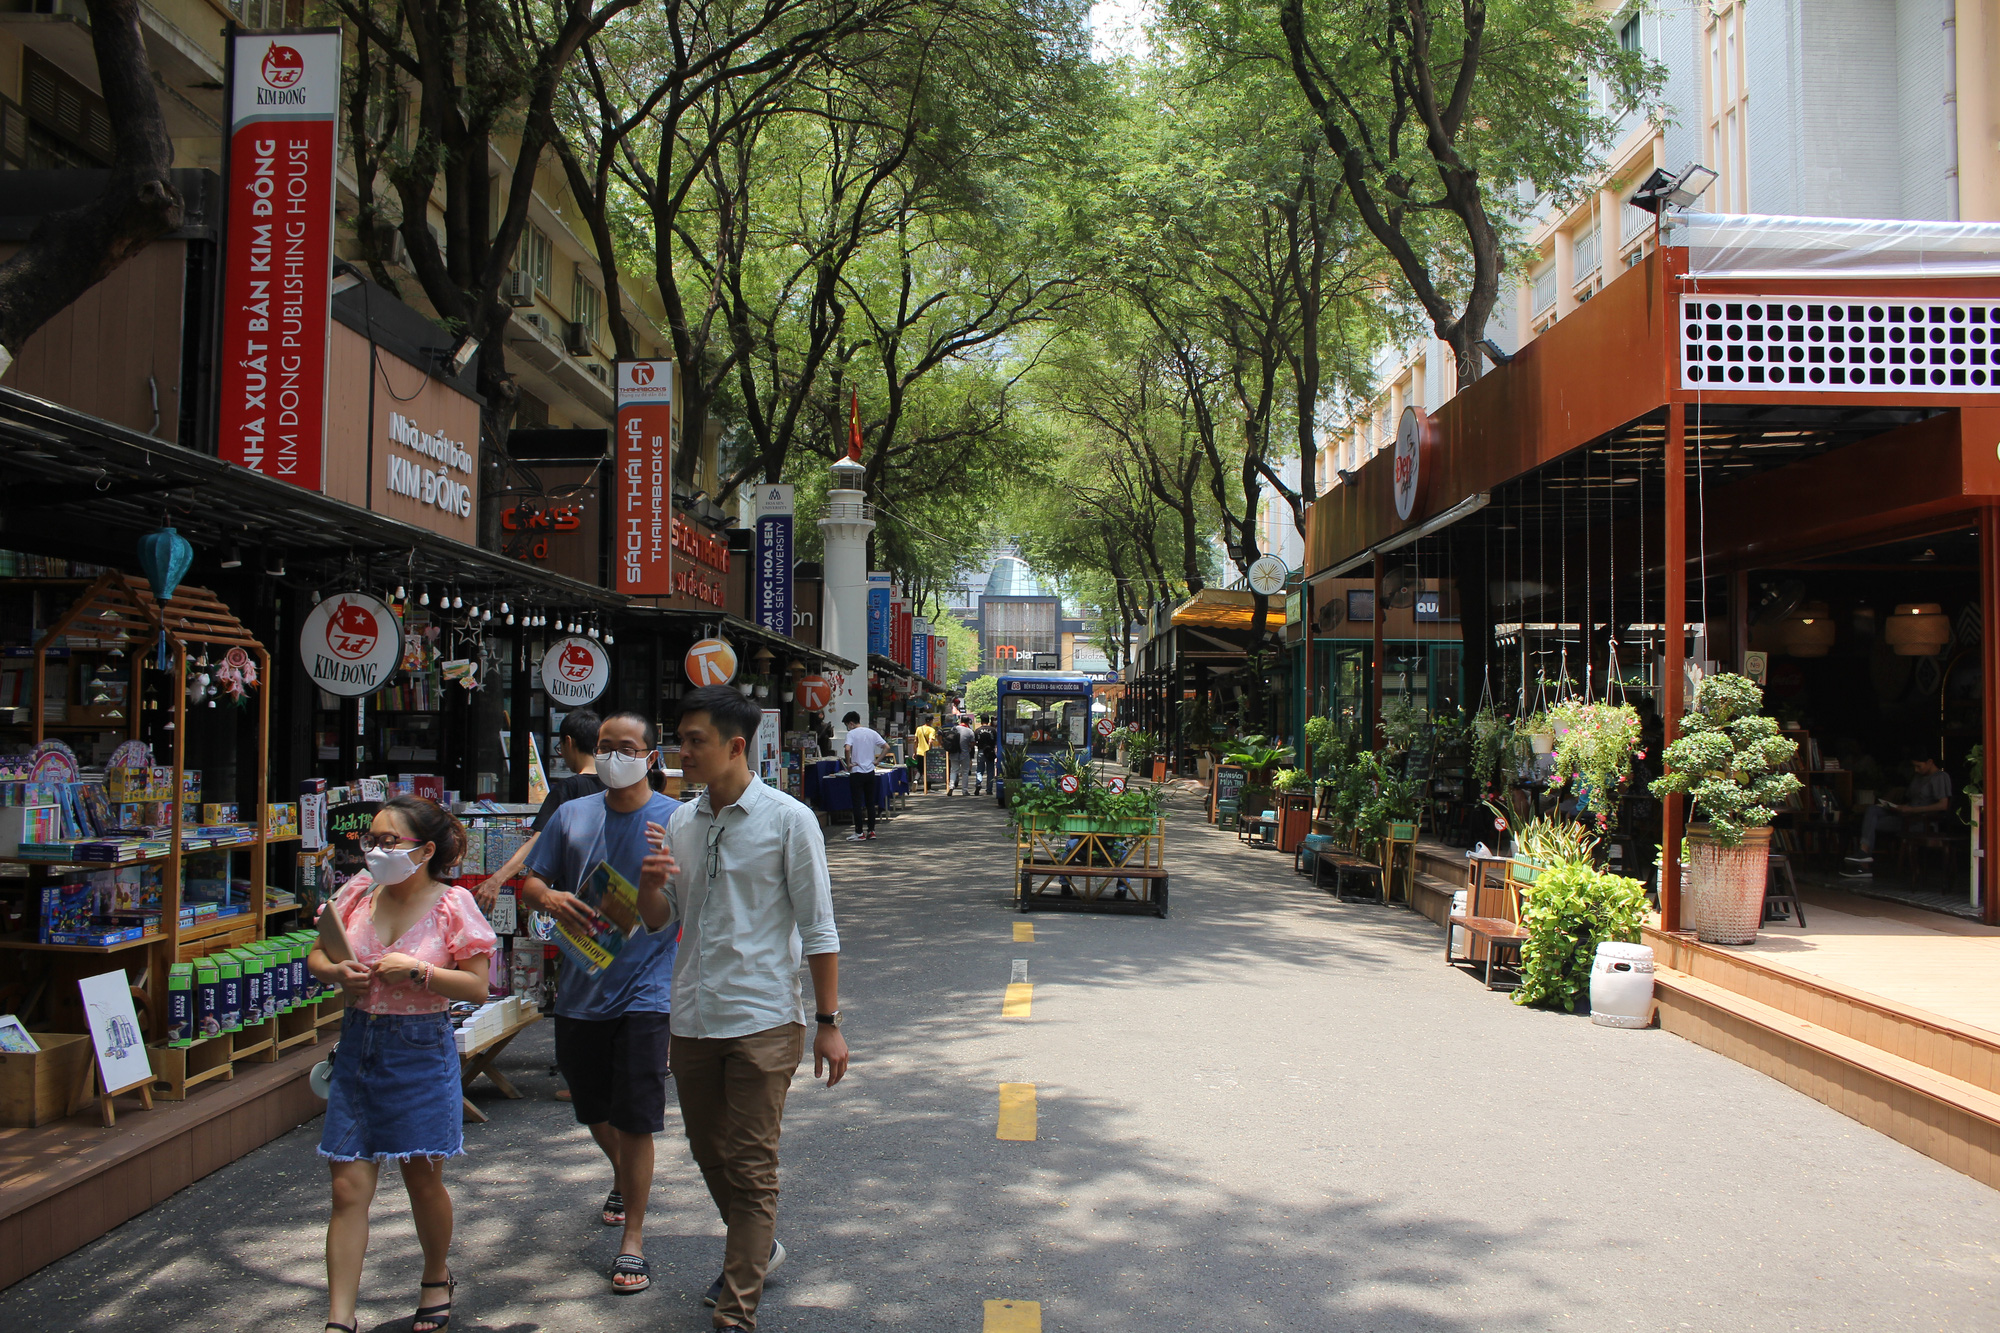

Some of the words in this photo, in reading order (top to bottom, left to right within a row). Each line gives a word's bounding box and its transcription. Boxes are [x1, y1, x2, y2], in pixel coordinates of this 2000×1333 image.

[257, 87, 277, 105] KIM
[246, 140, 276, 217] ĐỒNG
[286, 140, 309, 214] HOUSE
[250, 224, 273, 272] KIM
[242, 281, 271, 332] BẢN
[281, 222, 306, 347] PUBLISHING
[239, 339, 268, 410] XUẤT
[279, 356, 301, 426] DONG
[239, 417, 266, 473] NHÀ
[277, 434, 298, 474] KIM
[389, 411, 418, 451] Nhà
[417, 430, 448, 463] xuất
[448, 441, 472, 474] bản
[624, 418, 642, 452] HÀ
[386, 454, 420, 499] KIM
[421, 465, 471, 518] ĐỒNG
[624, 458, 642, 512] THÁI
[651, 435, 663, 562] THAIHABOOKS
[623, 518, 642, 583] SÁCH
[764, 522, 773, 547] SEN
[775, 522, 785, 584] UNIVERSITY
[764, 550, 773, 578] HOA
[764, 581, 775, 608] HỌC
[775, 591, 784, 608] SEN
[775, 612, 784, 635] HOA
[314, 653, 341, 681] KIM
[551, 678, 571, 697] KIM
[419, 787, 438, 799] 10%
[42, 889, 50, 903] 100
[52, 935, 65, 943] 100
